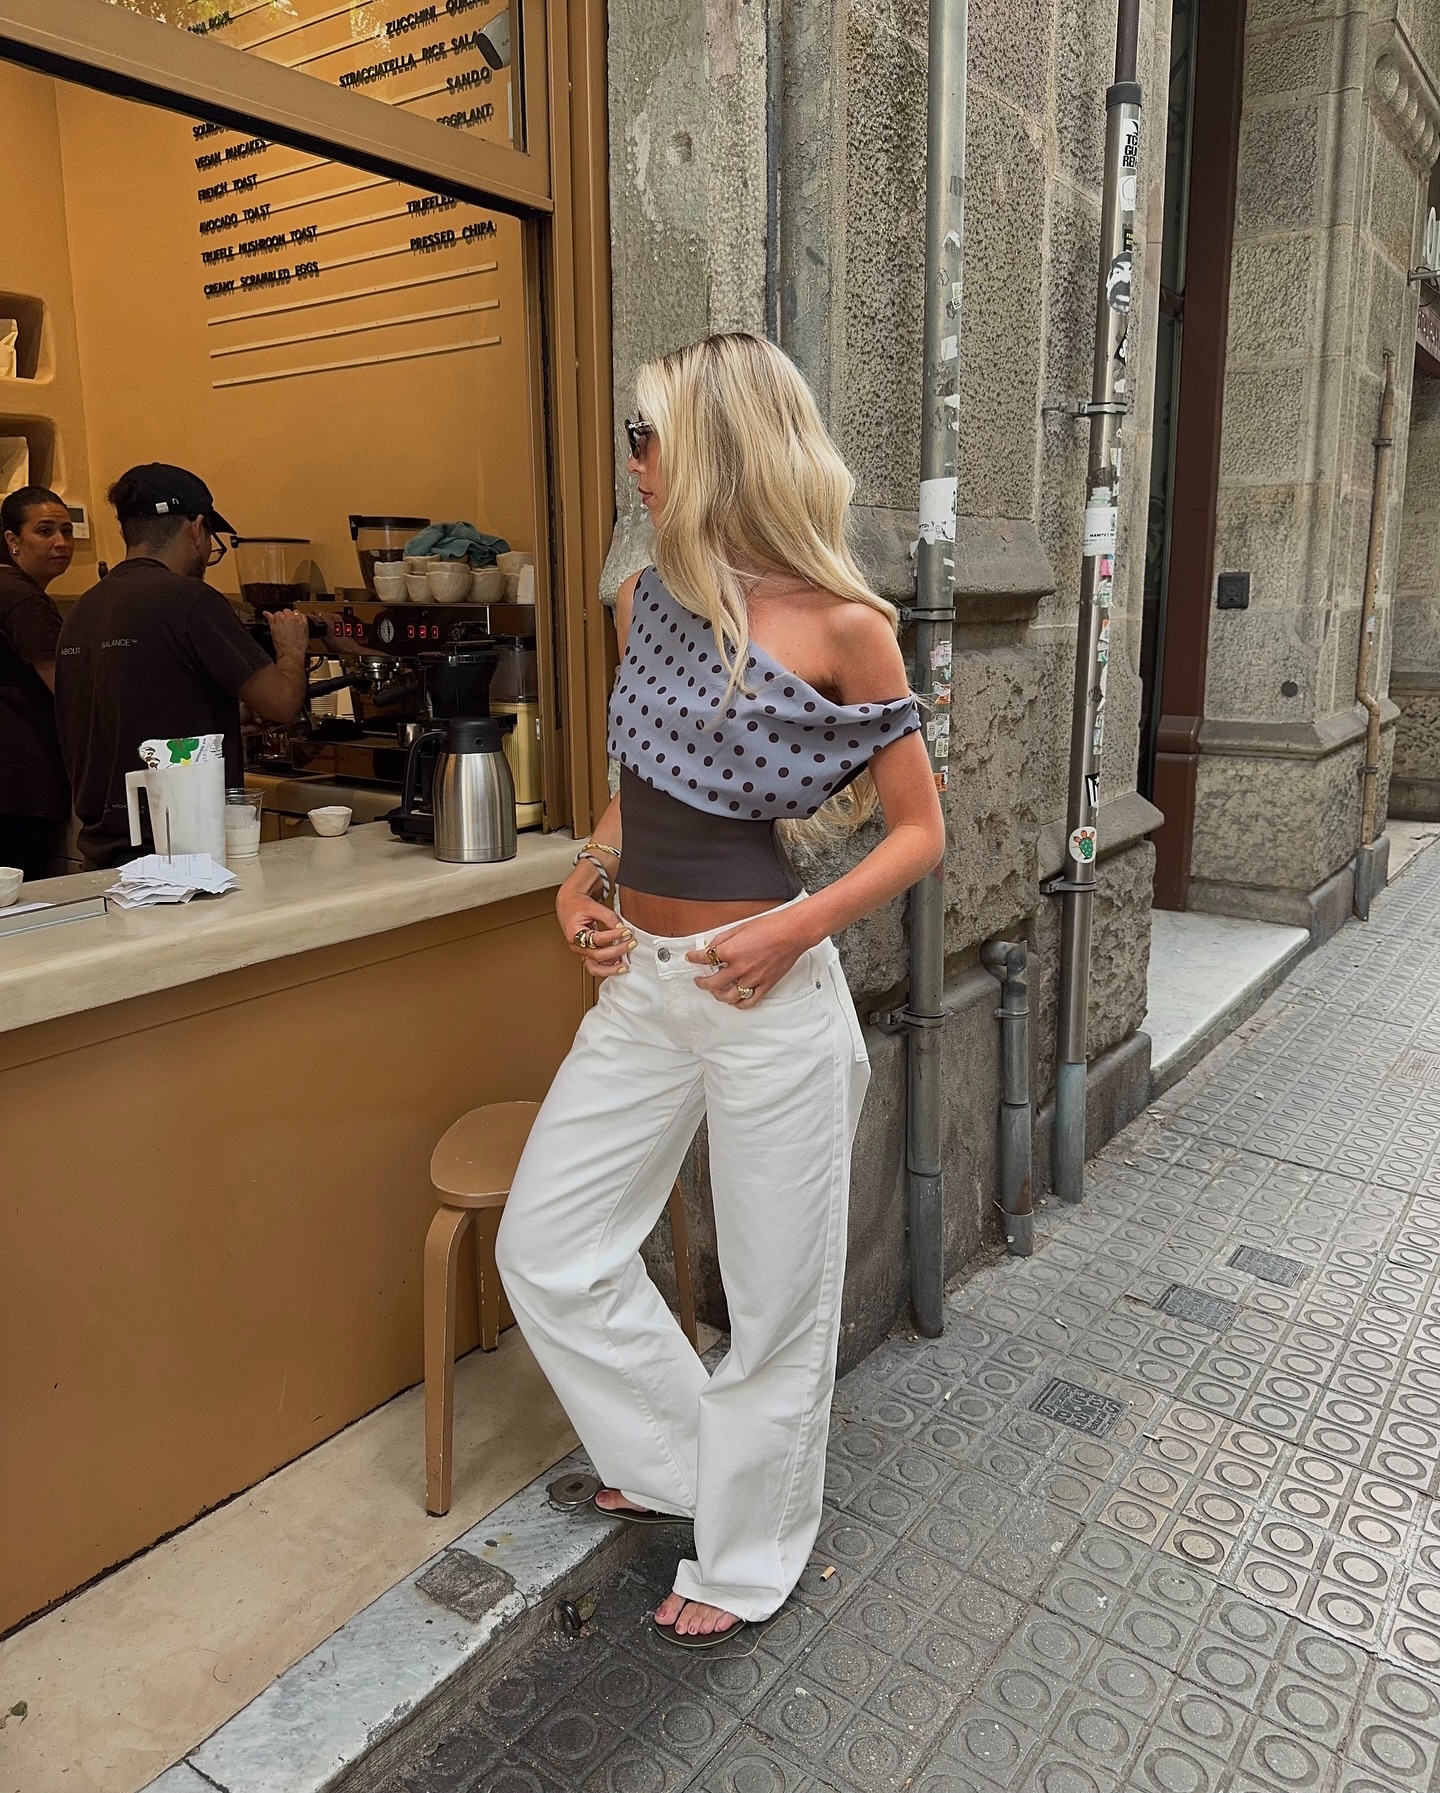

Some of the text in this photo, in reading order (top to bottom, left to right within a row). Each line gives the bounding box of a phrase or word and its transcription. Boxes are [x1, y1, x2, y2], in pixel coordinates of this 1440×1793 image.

[385, 4, 436, 35] ZUCCHINI
[339, 28, 481, 87] STRACCIATELLA RICE SALA
[446, 66, 490, 90] SANDO
[195, 138, 266, 169] VEGAN PANCAKES
[198, 173, 258, 201] FRENCH TOAST
[199, 203, 271, 233] AVOCADO TOAST
[201, 225, 318, 263] TRUFFLE MUSHROOM TOAST
[410, 220, 496, 250] PRESSED CHIPA
[204, 261, 319, 295] CREAMY SCRAMBLED EGGS
[61, 646, 80, 656] ABOUT
